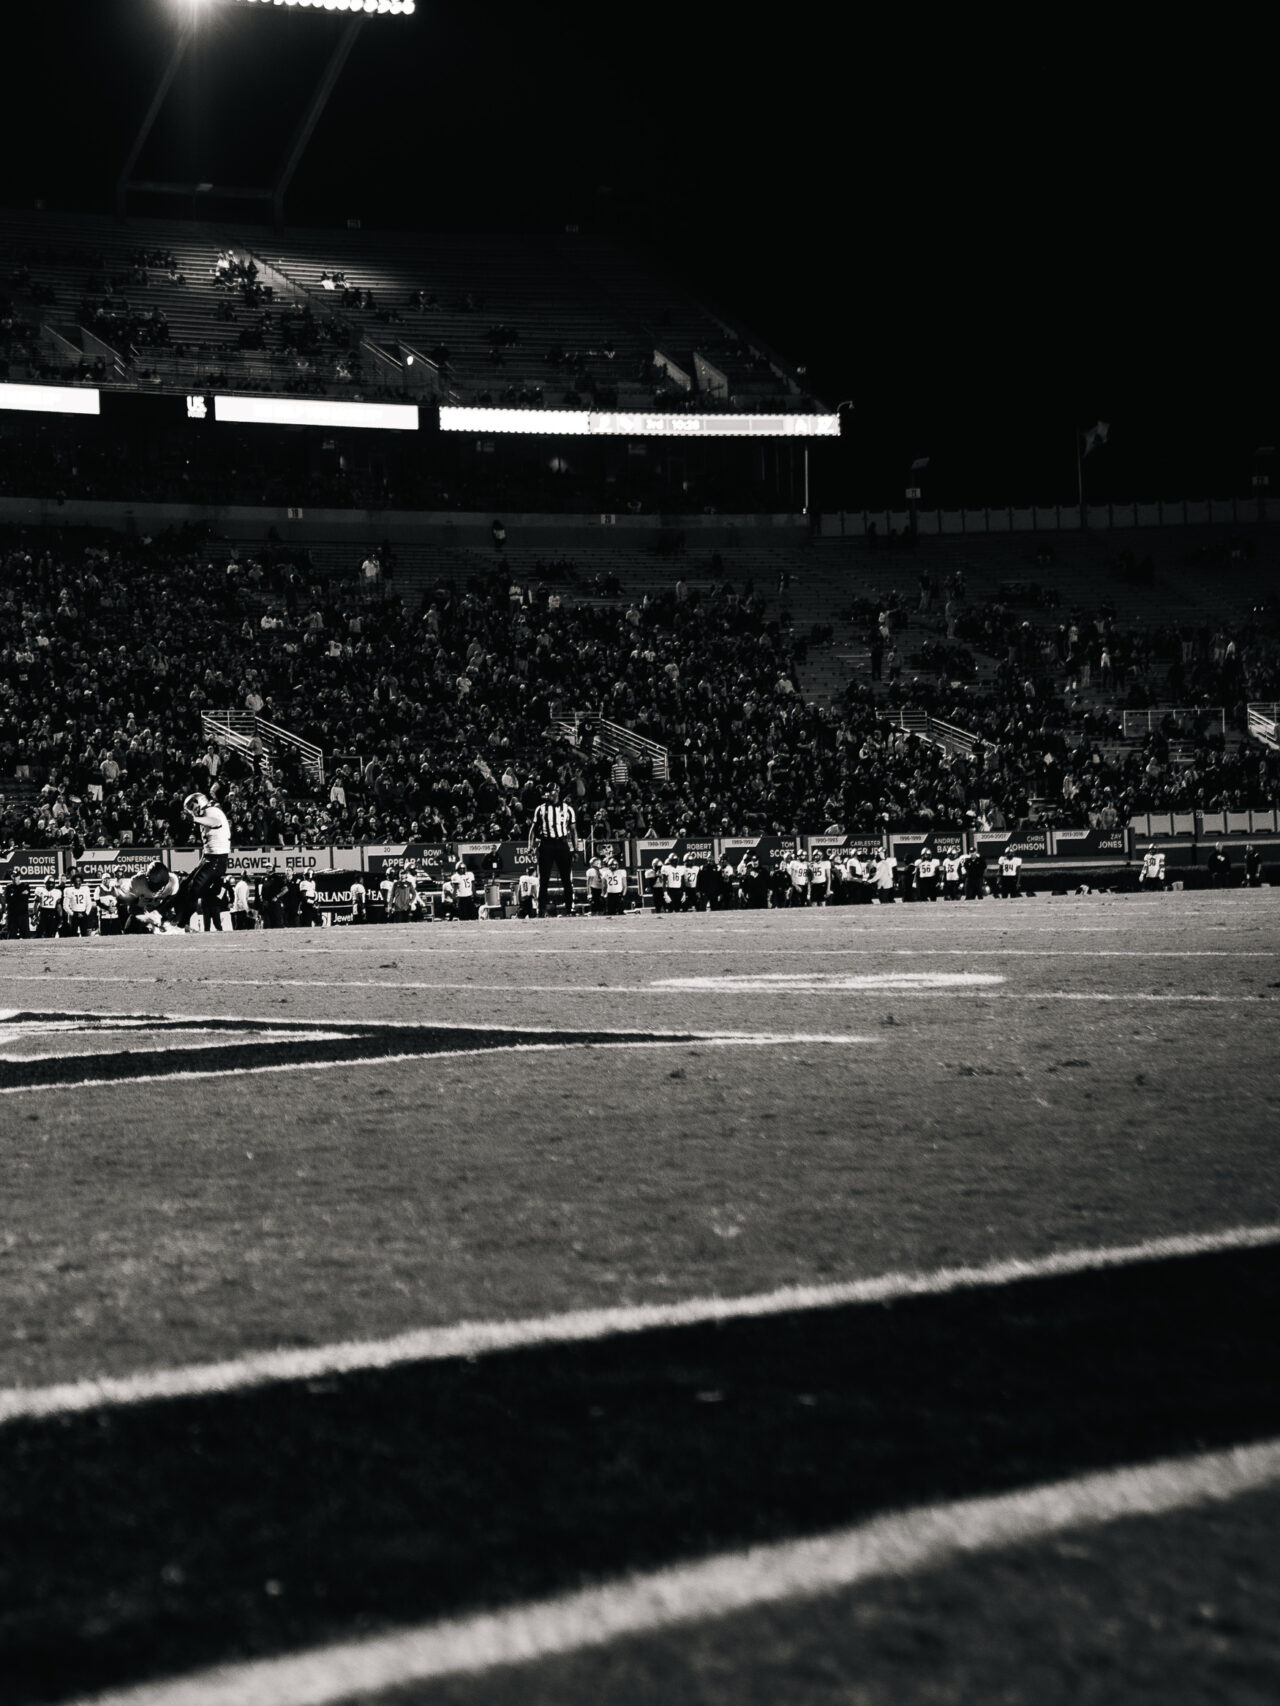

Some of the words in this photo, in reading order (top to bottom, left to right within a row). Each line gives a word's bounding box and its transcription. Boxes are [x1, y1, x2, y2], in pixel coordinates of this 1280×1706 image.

[1098, 841, 1123, 849] JONES
[27, 856, 56, 864] TOOTIE
[116, 855, 161, 863] CONFERENCE
[286, 856, 317, 868] FIELD
[513, 855, 538, 864] LONG
[921, 864, 931, 873] 56
[608, 876, 618, 886] 25
[43, 895, 54, 906] 22
[74, 894, 84, 905] 12
